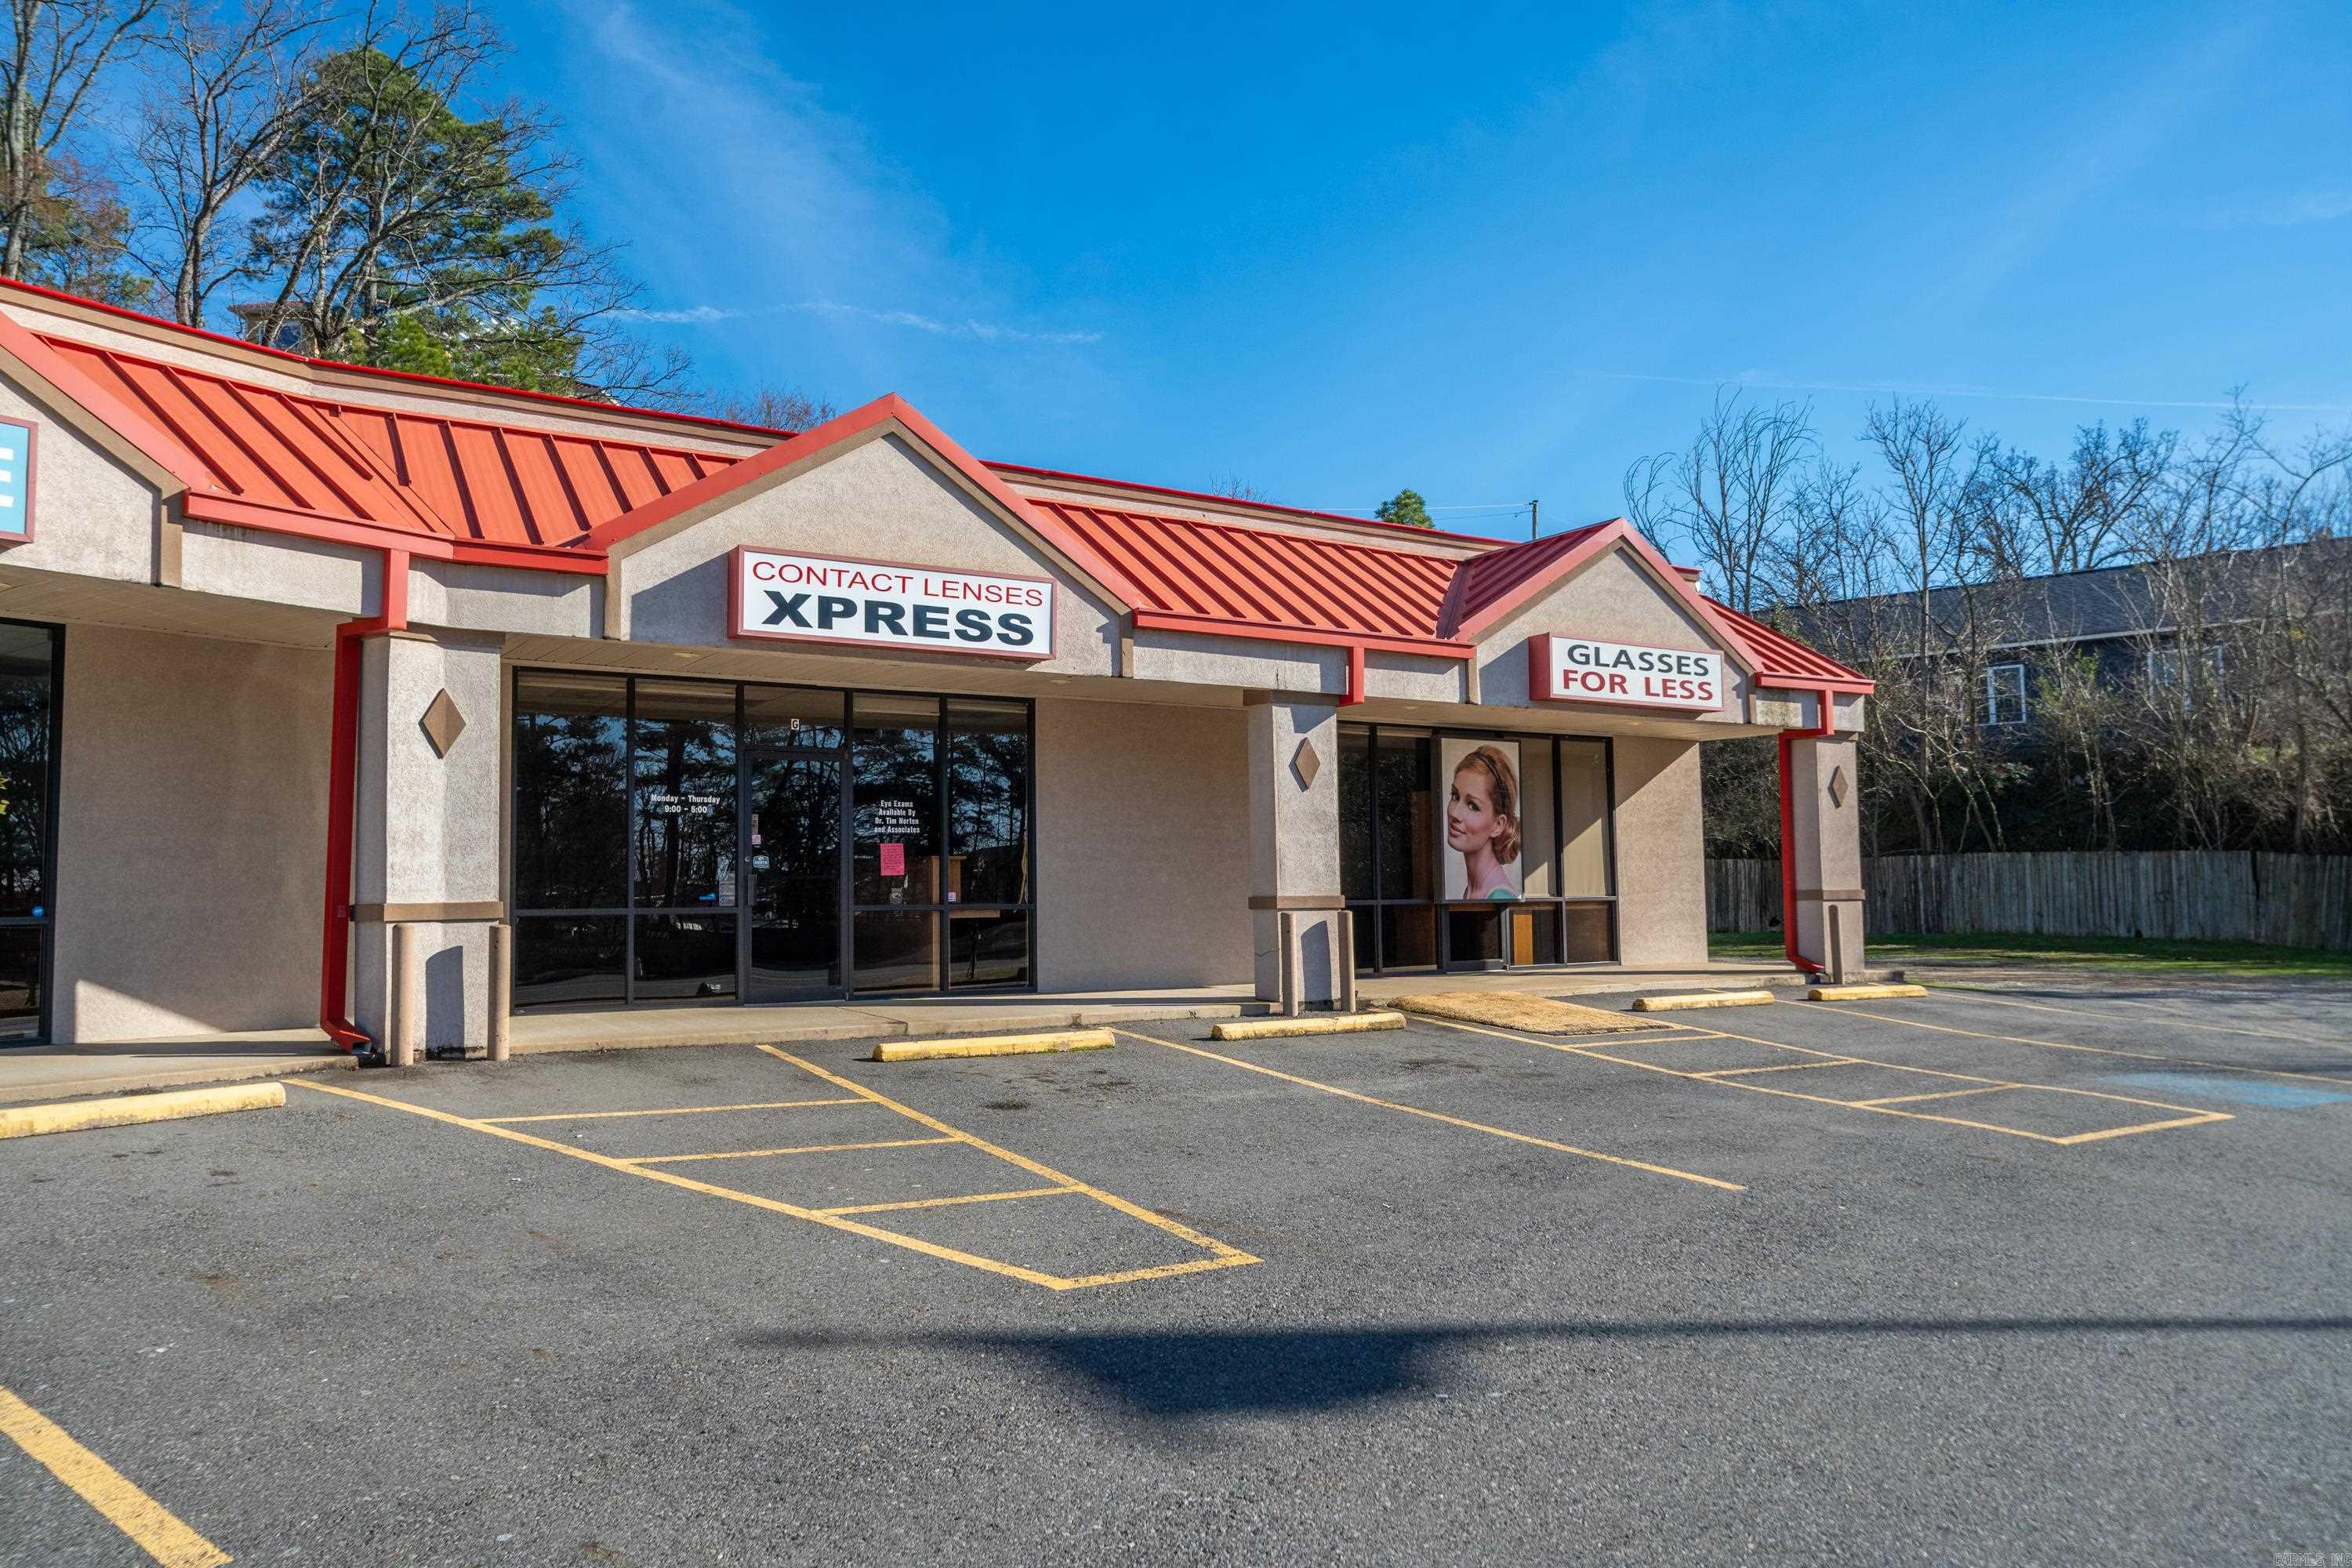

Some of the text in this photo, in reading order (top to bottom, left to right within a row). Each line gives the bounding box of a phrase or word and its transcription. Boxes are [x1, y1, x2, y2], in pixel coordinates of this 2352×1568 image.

[753, 561, 1043, 607] CONTACT LENSES
[761, 590, 1034, 646] XPRESS
[1567, 644, 1709, 677] GLASSES
[1563, 669, 1713, 701] FOR LESS
[792, 720, 799, 729] G
[651, 793, 679, 804] Monday
[688, 794, 720, 804] Thursday
[880, 800, 891, 808] Eye
[664, 804, 681, 813] 9:00
[691, 805, 707, 814] 5:00
[908, 808, 916, 817] By
